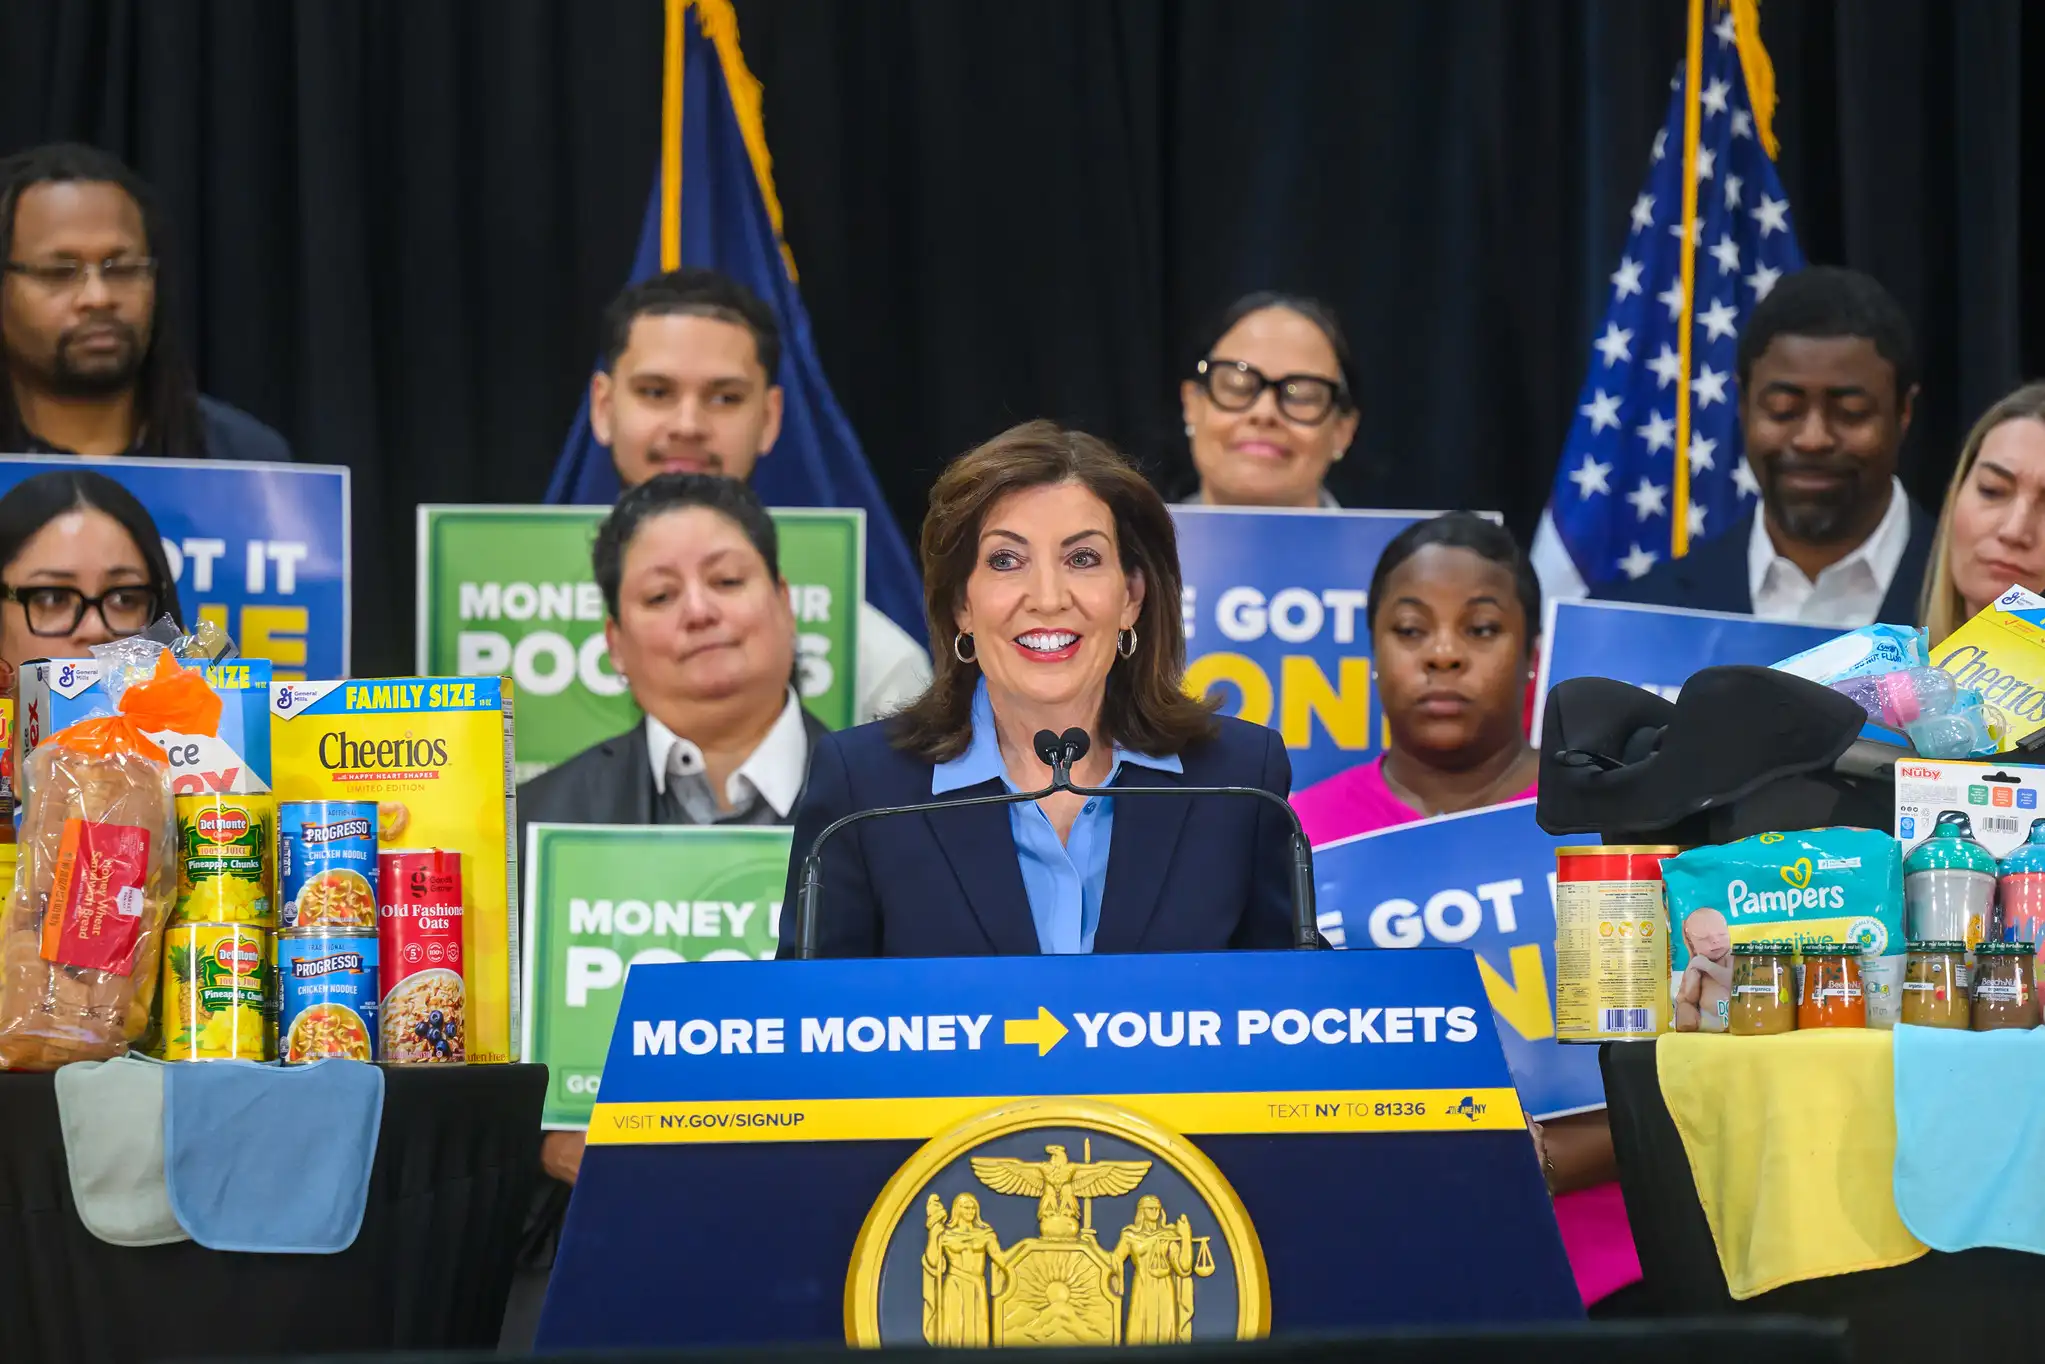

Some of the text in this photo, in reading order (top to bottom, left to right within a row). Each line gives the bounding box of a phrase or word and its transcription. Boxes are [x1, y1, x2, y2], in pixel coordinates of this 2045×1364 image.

[247, 539, 307, 594] IT
[458, 581, 600, 622] MONE
[1215, 586, 1367, 643] GOT
[205, 665, 250, 689] SIZE
[1938, 645, 2045, 723] Cheerios
[346, 685, 425, 710] FAMILY
[428, 683, 476, 708] SIZE
[318, 730, 449, 769] Cheerios
[376, 772, 402, 780] HEART
[403, 772, 434, 780] SHAPES
[346, 783, 426, 793] LIMITED EDITION
[200, 819, 247, 830] Del Monte
[306, 821, 368, 842] PROGRESSO
[188, 860, 259, 869] Pineapple Chunks
[309, 849, 368, 860] CHICKEN NOODLE
[1727, 879, 1845, 918] Pampers
[381, 904, 409, 918] Old
[569, 897, 756, 938] MONEY
[1368, 877, 1524, 949] GOT
[418, 916, 449, 929] Oats
[296, 955, 358, 977] PROGRESSO
[204, 990, 245, 999] Pineaple
[297, 984, 358, 995] CHICKEN NOODLE
[632, 1006, 1479, 1056] MORE MONEY YOUR POCKETS
[1268, 1102, 1426, 1118] TEXT NY TO 81336
[613, 1113, 805, 1129] VISIT NY.GOV/SIGNUP
